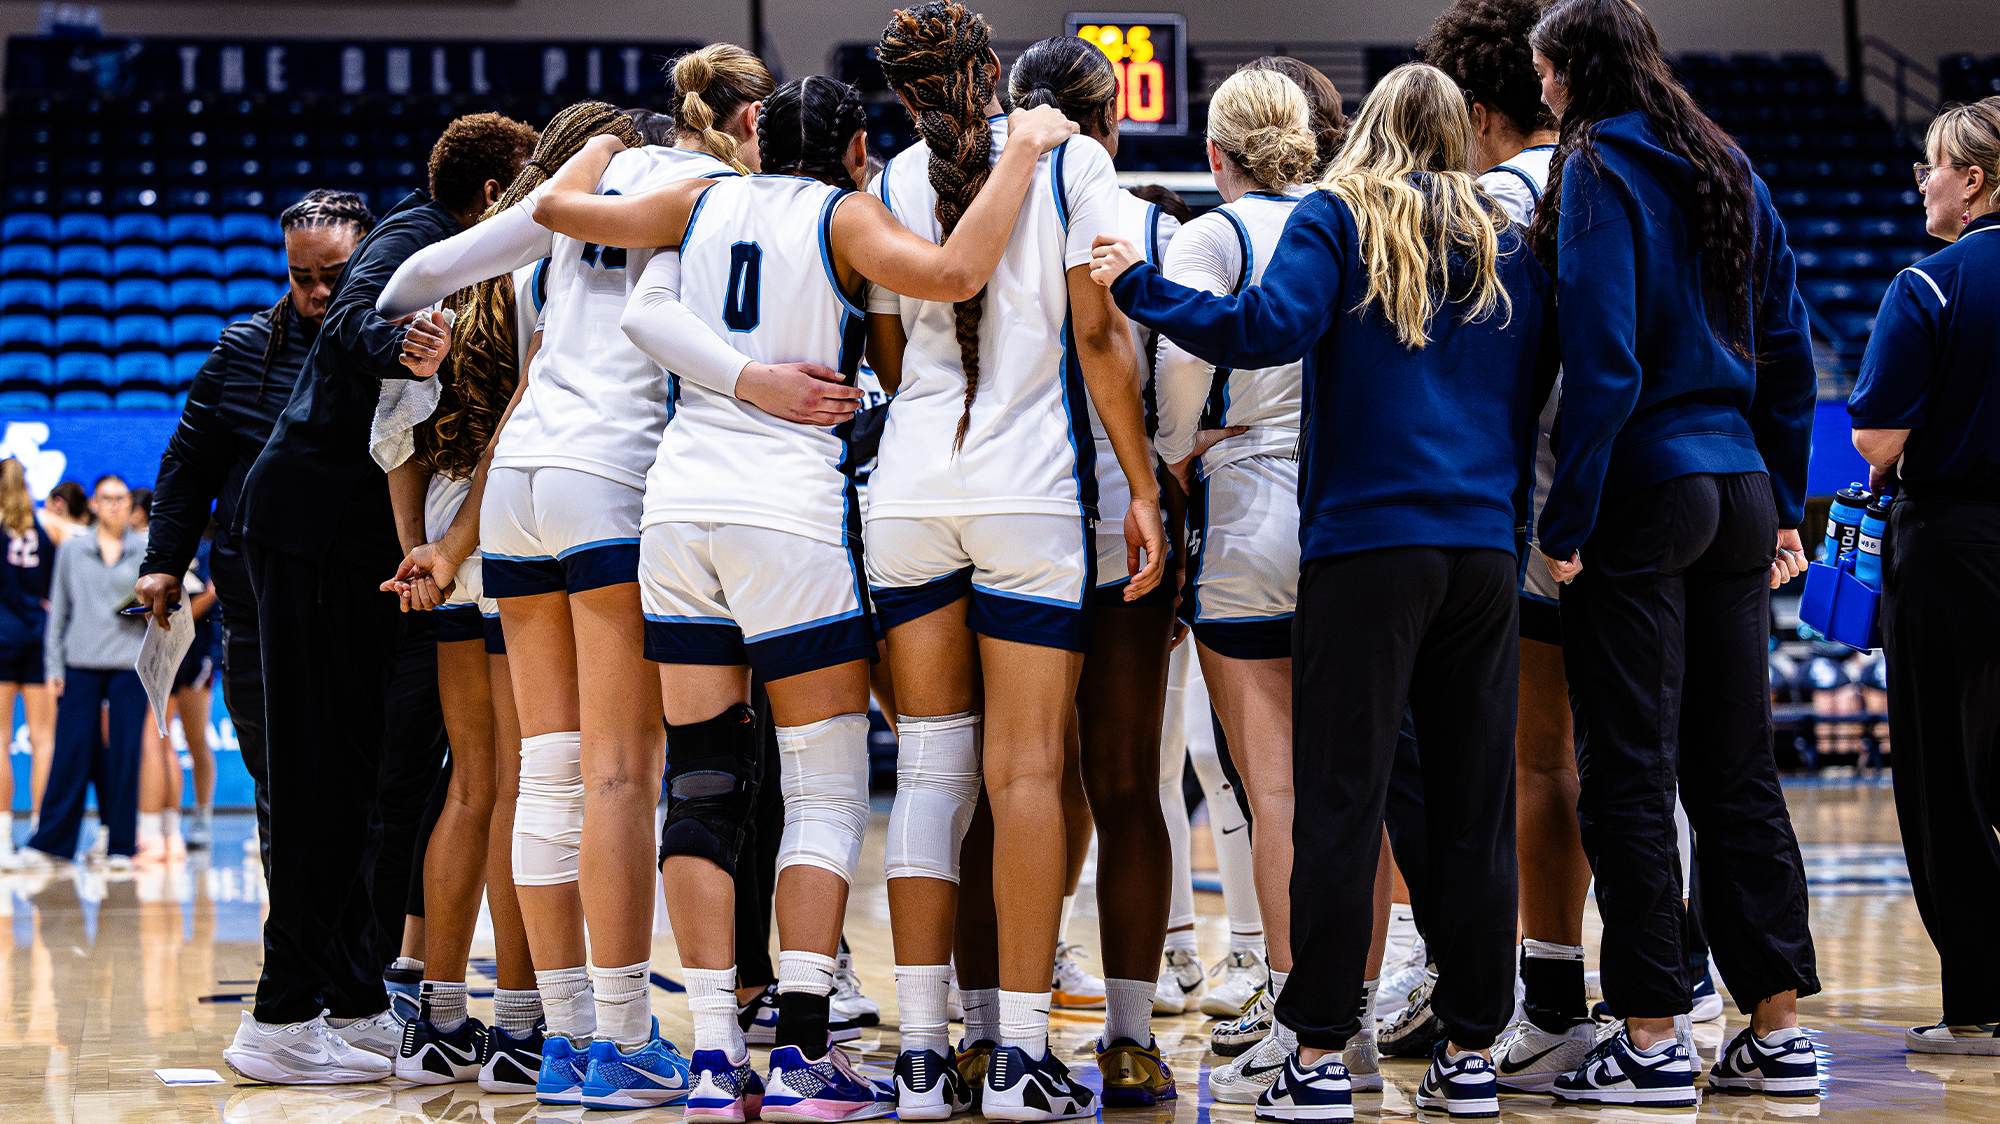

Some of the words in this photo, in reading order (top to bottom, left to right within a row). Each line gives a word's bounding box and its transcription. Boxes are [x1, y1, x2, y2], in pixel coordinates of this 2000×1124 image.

[178, 45, 288, 95] THE
[340, 45, 492, 95] BULL
[543, 46, 643, 95] PIT
[722, 240, 763, 333] 0
[1793, 1039, 1811, 1050] NIKE
[1325, 1065, 1346, 1075] NIKE
[1464, 1059, 1484, 1070] NIKE
